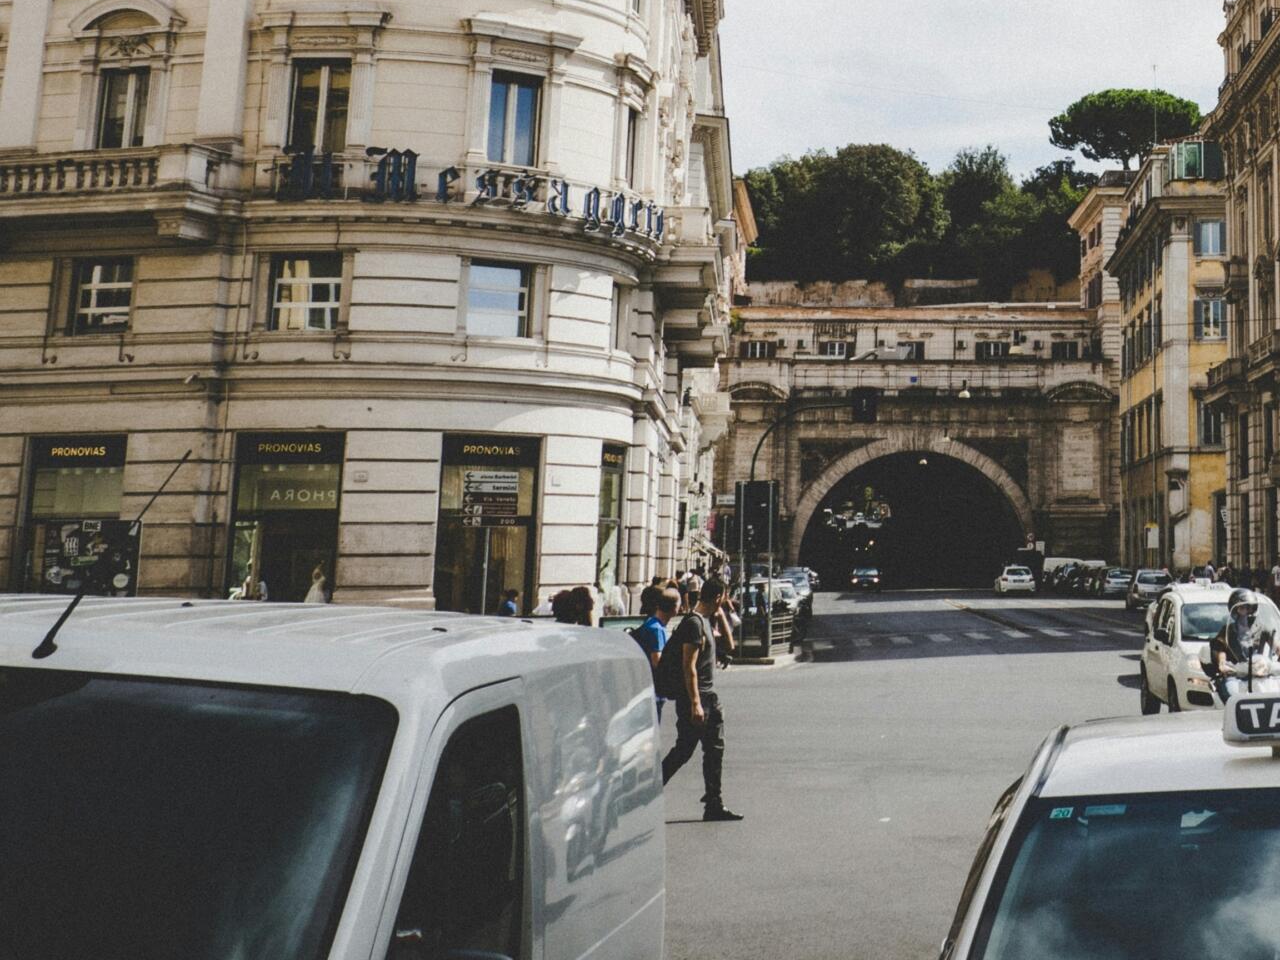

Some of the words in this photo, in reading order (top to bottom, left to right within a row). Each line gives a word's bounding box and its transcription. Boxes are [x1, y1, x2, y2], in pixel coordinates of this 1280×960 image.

[51, 446, 106, 456] PRONOVIAS
[258, 443, 321, 453] PRONOVIAS
[463, 445, 520, 455] PRONOVIAS
